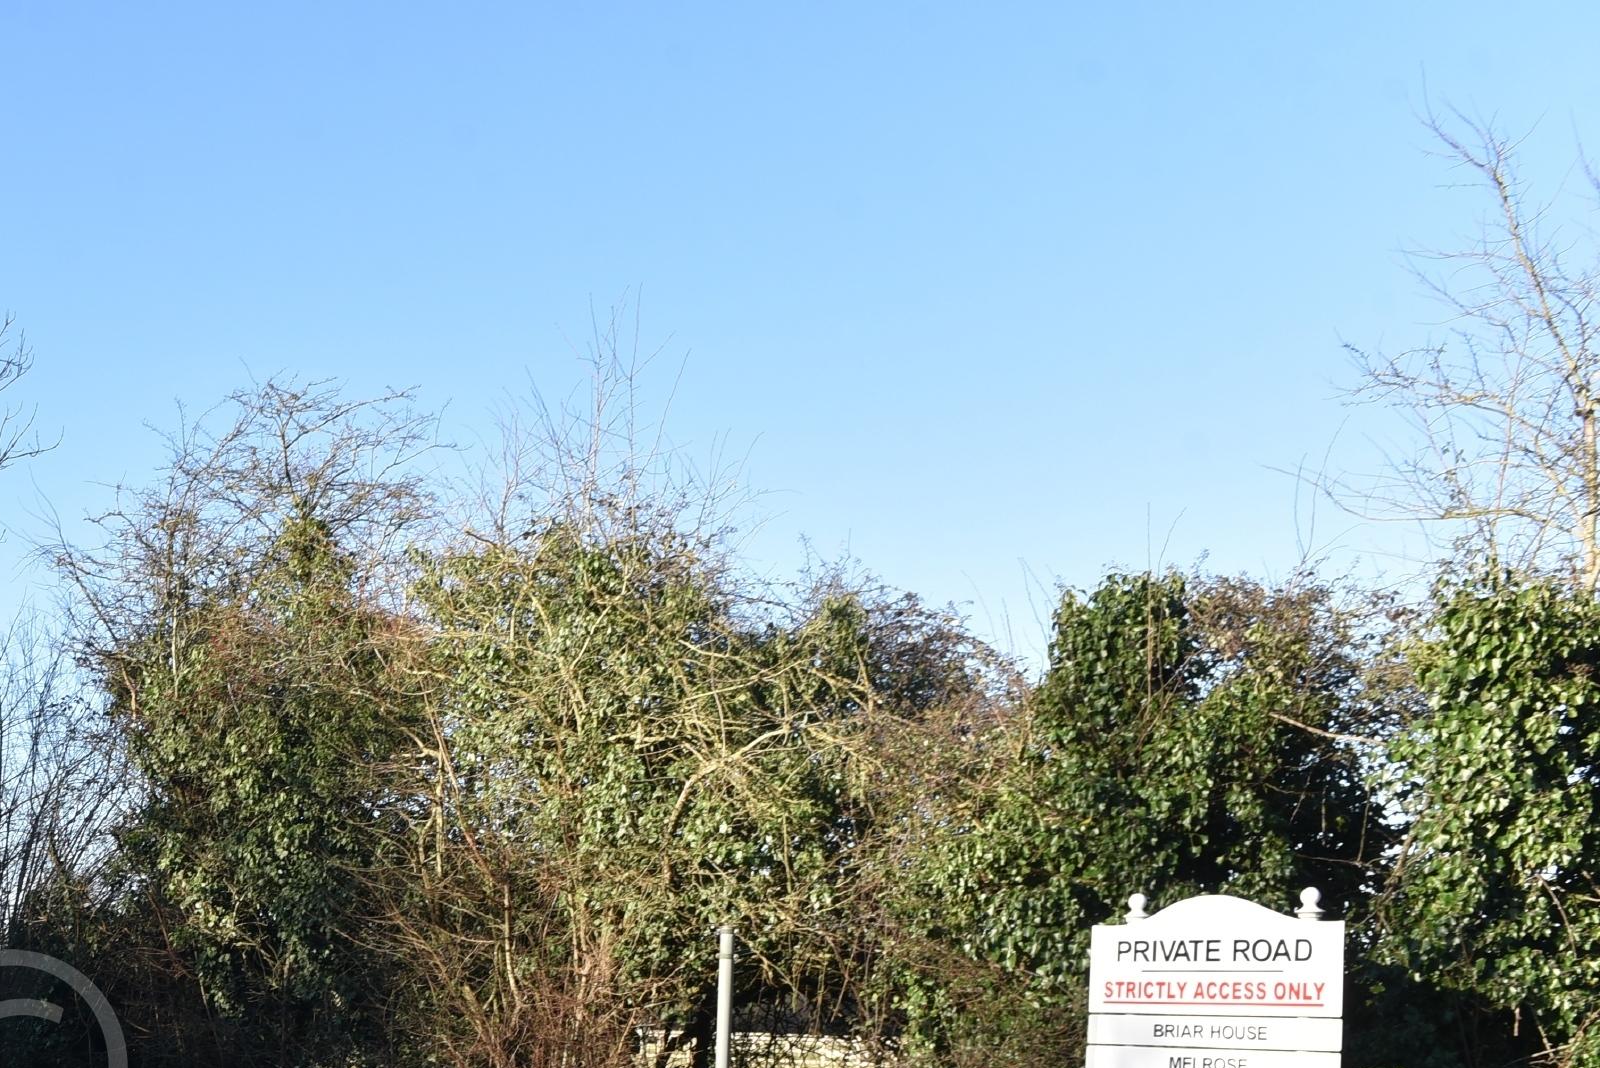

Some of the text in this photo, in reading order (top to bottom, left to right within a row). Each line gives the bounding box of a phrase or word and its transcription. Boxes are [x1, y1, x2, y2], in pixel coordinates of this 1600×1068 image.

[1117, 939, 1313, 962] PRIVATE ROAD
[1104, 981, 1326, 1001] STRICTLY ACCESS ONLY
[1153, 1024, 1268, 1041] BRIAR HOUSE
